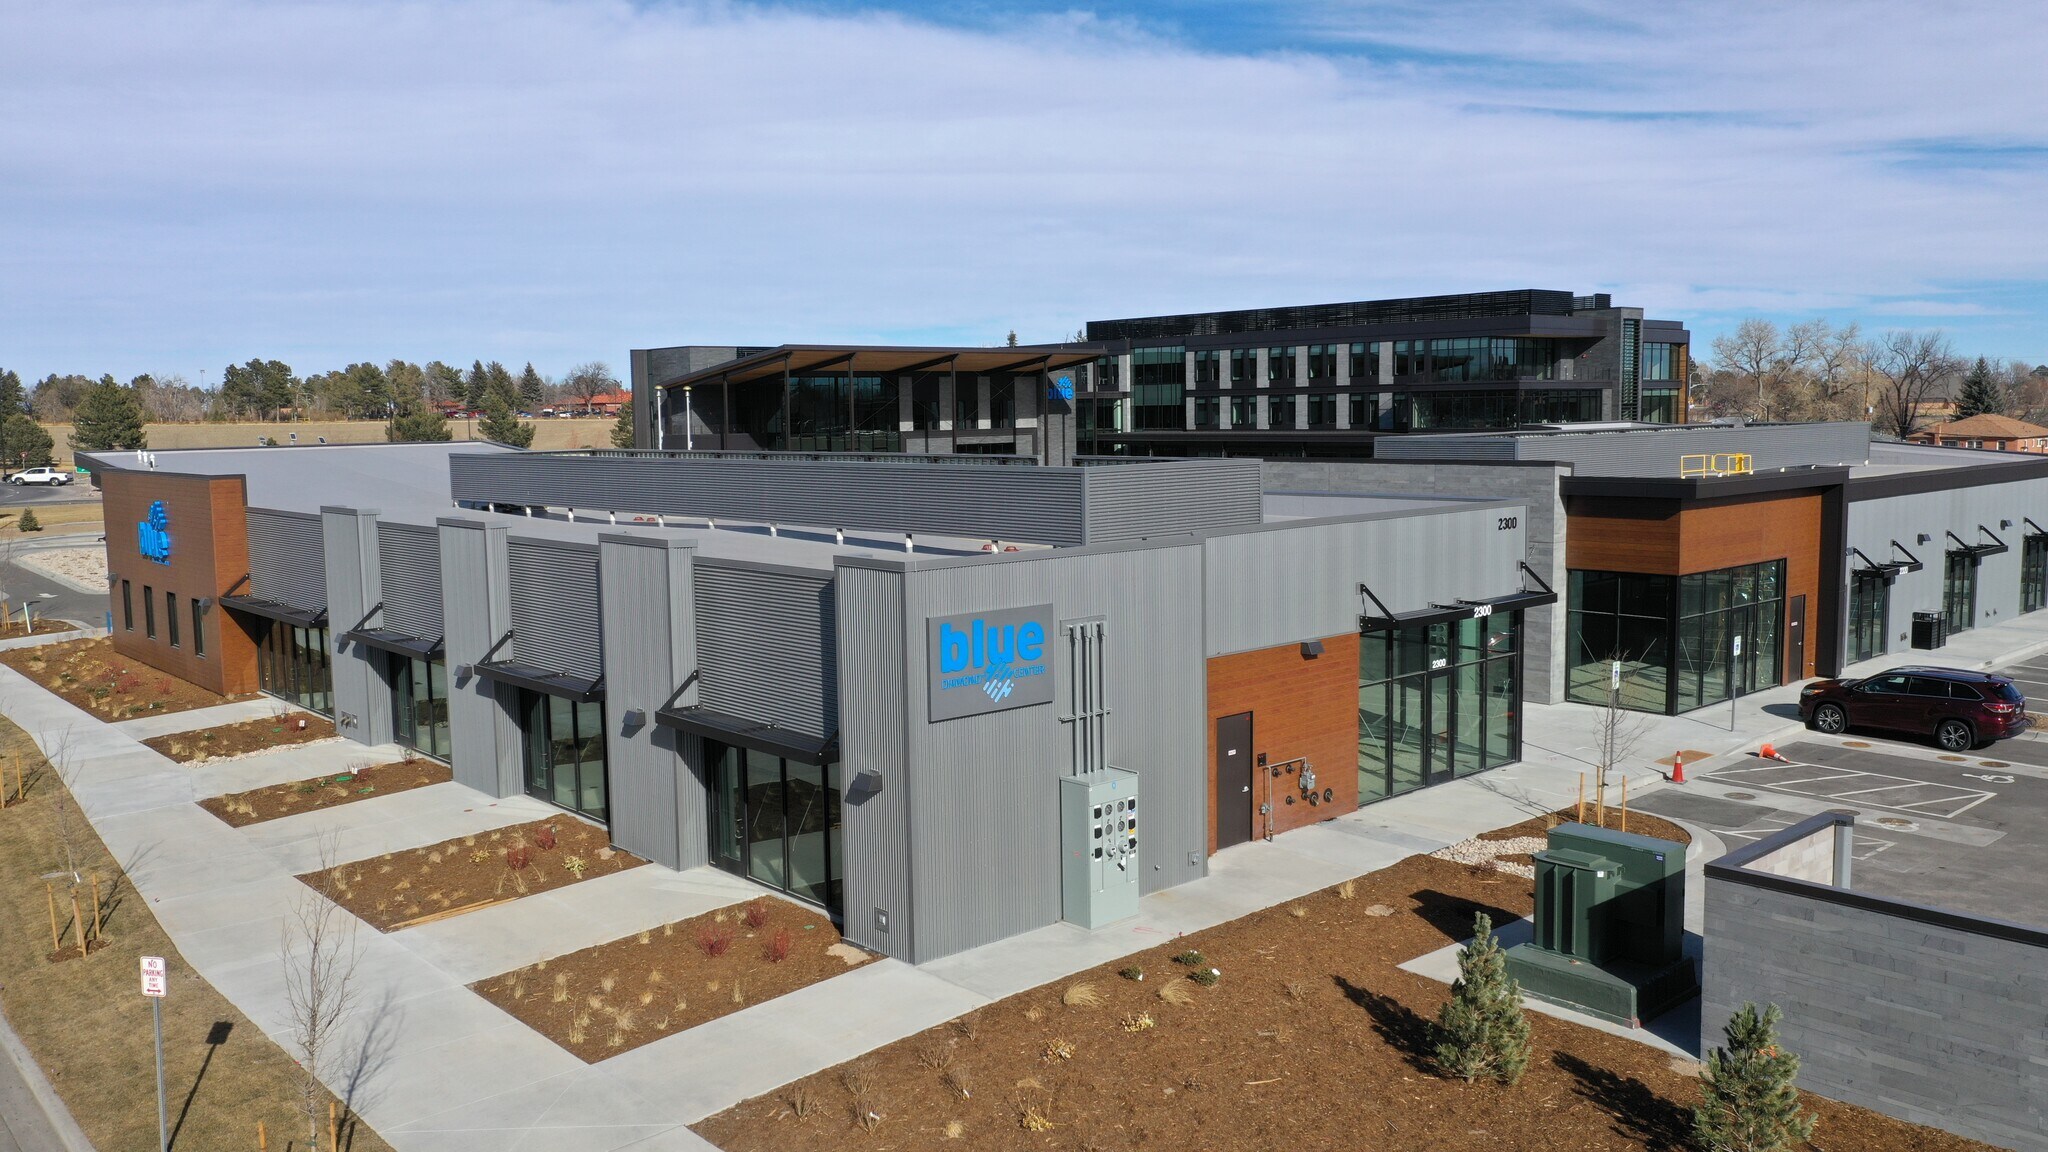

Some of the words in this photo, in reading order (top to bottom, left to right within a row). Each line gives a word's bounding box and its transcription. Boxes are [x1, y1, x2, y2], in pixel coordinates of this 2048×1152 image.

[1498, 517, 1517, 531] 2300
[1474, 605, 1492, 618] 2300
[940, 619, 1045, 674] blue
[1432, 659, 1447, 669] 2300
[1013, 665, 1046, 679] CENTER
[147, 960, 157, 968] NO
[143, 969, 163, 977] PARKING
